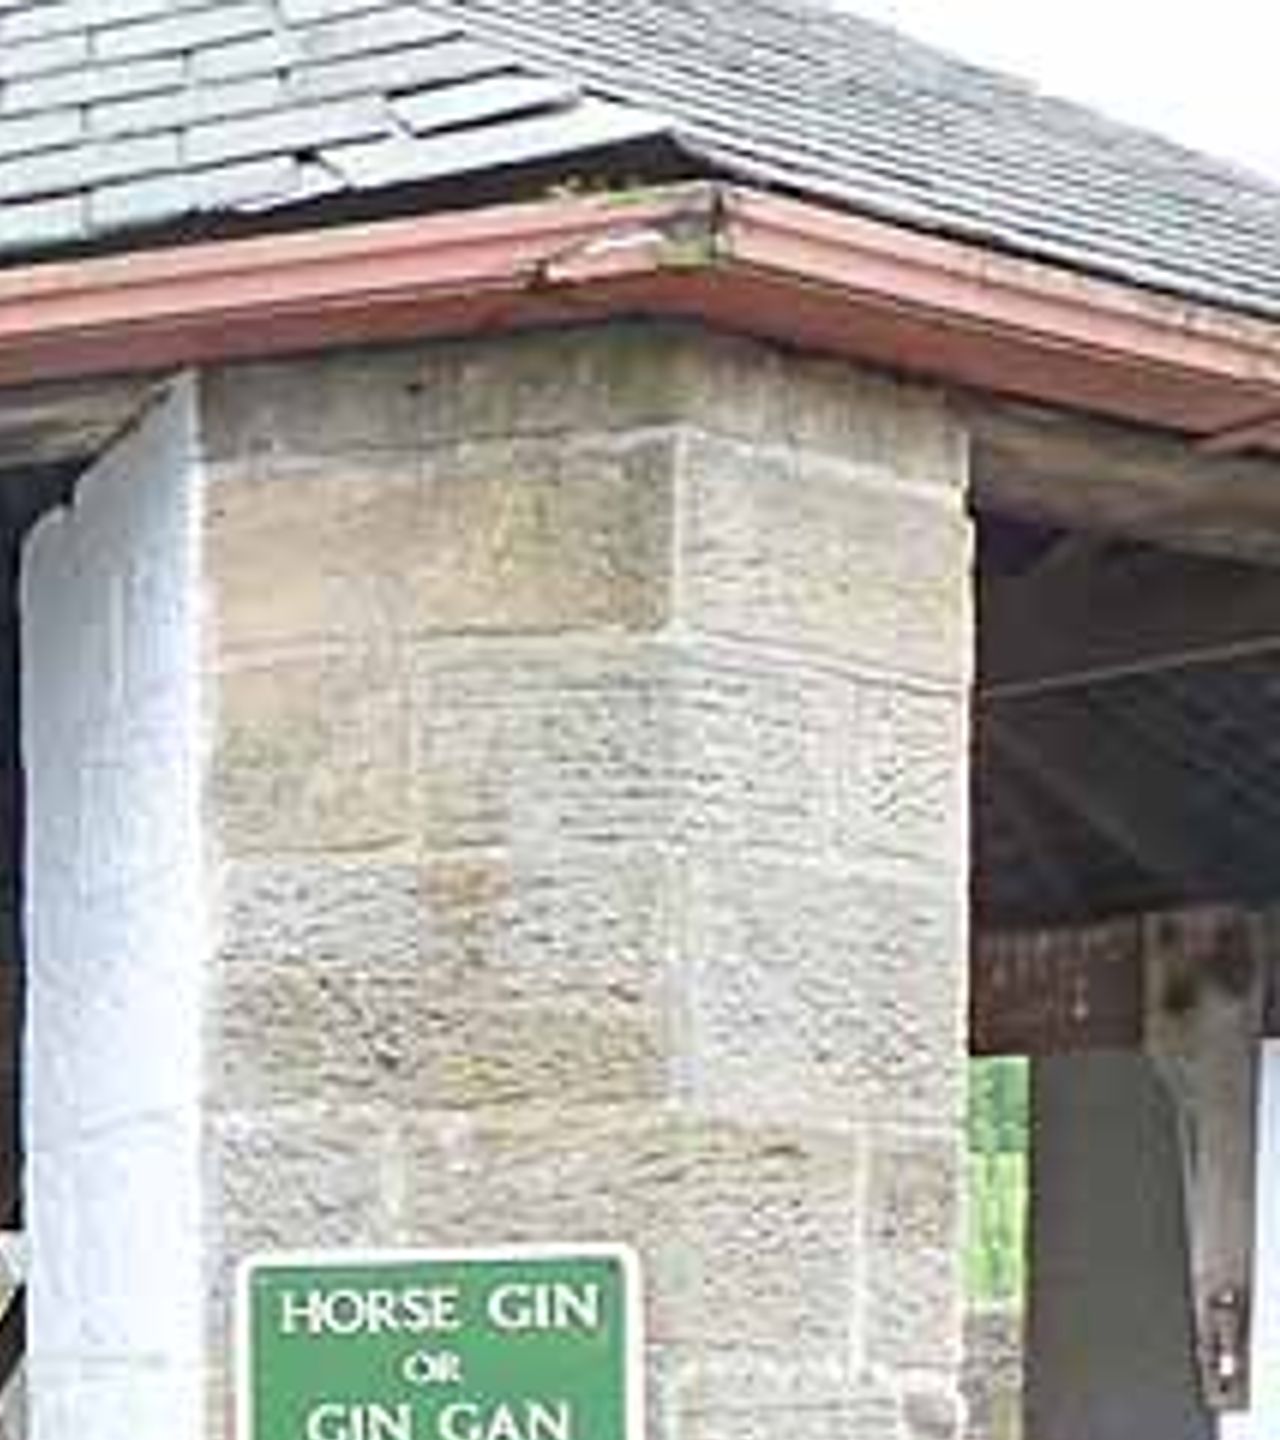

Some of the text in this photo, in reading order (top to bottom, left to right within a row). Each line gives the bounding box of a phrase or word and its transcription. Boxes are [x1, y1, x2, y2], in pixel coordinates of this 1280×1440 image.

[279, 1283, 599, 1334] HORSE GIN
[402, 1350, 462, 1383] OR
